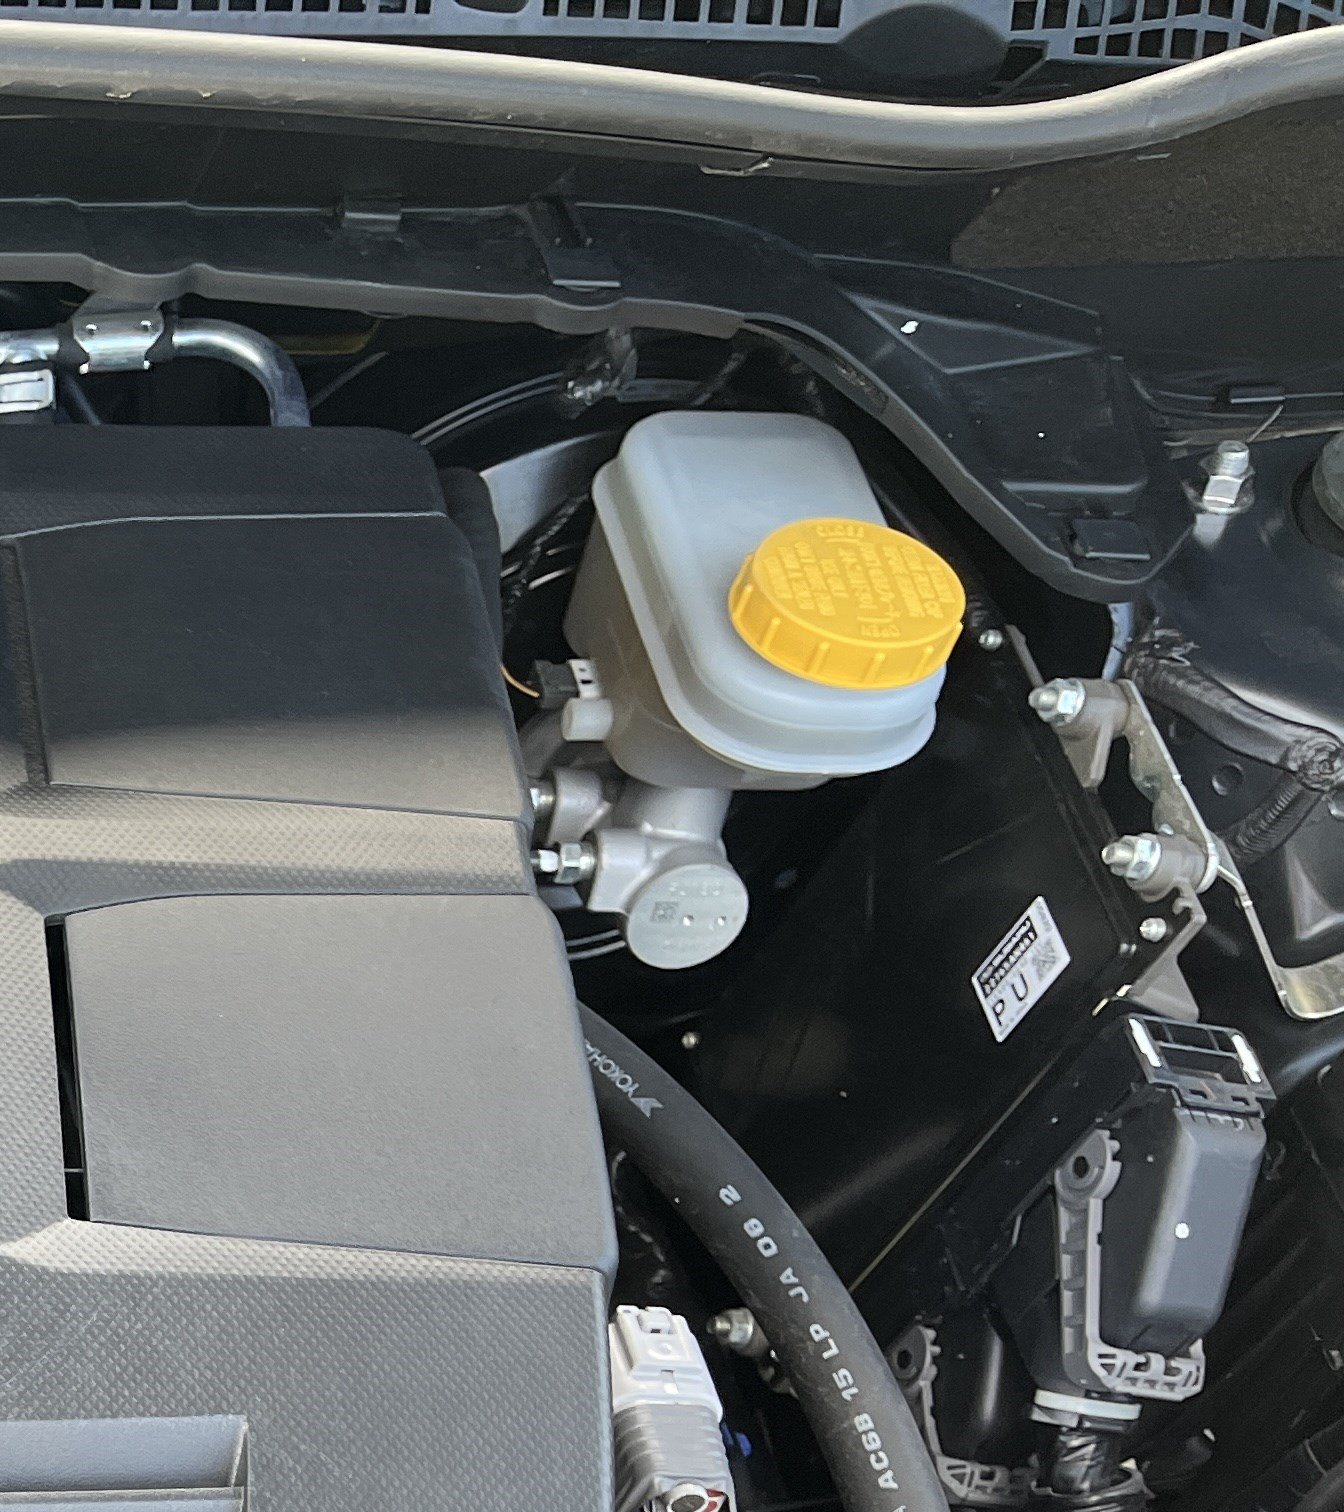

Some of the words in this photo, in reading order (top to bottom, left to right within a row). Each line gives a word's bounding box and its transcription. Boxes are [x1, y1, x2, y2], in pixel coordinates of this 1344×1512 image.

[993, 999, 1005, 1027] P
[1011, 973, 1029, 1002] U
[718, 1184, 742, 1206] 2
[779, 1266, 810, 1304] JA
[809, 1322, 840, 1360] LP
[832, 1367, 861, 1401] 15
